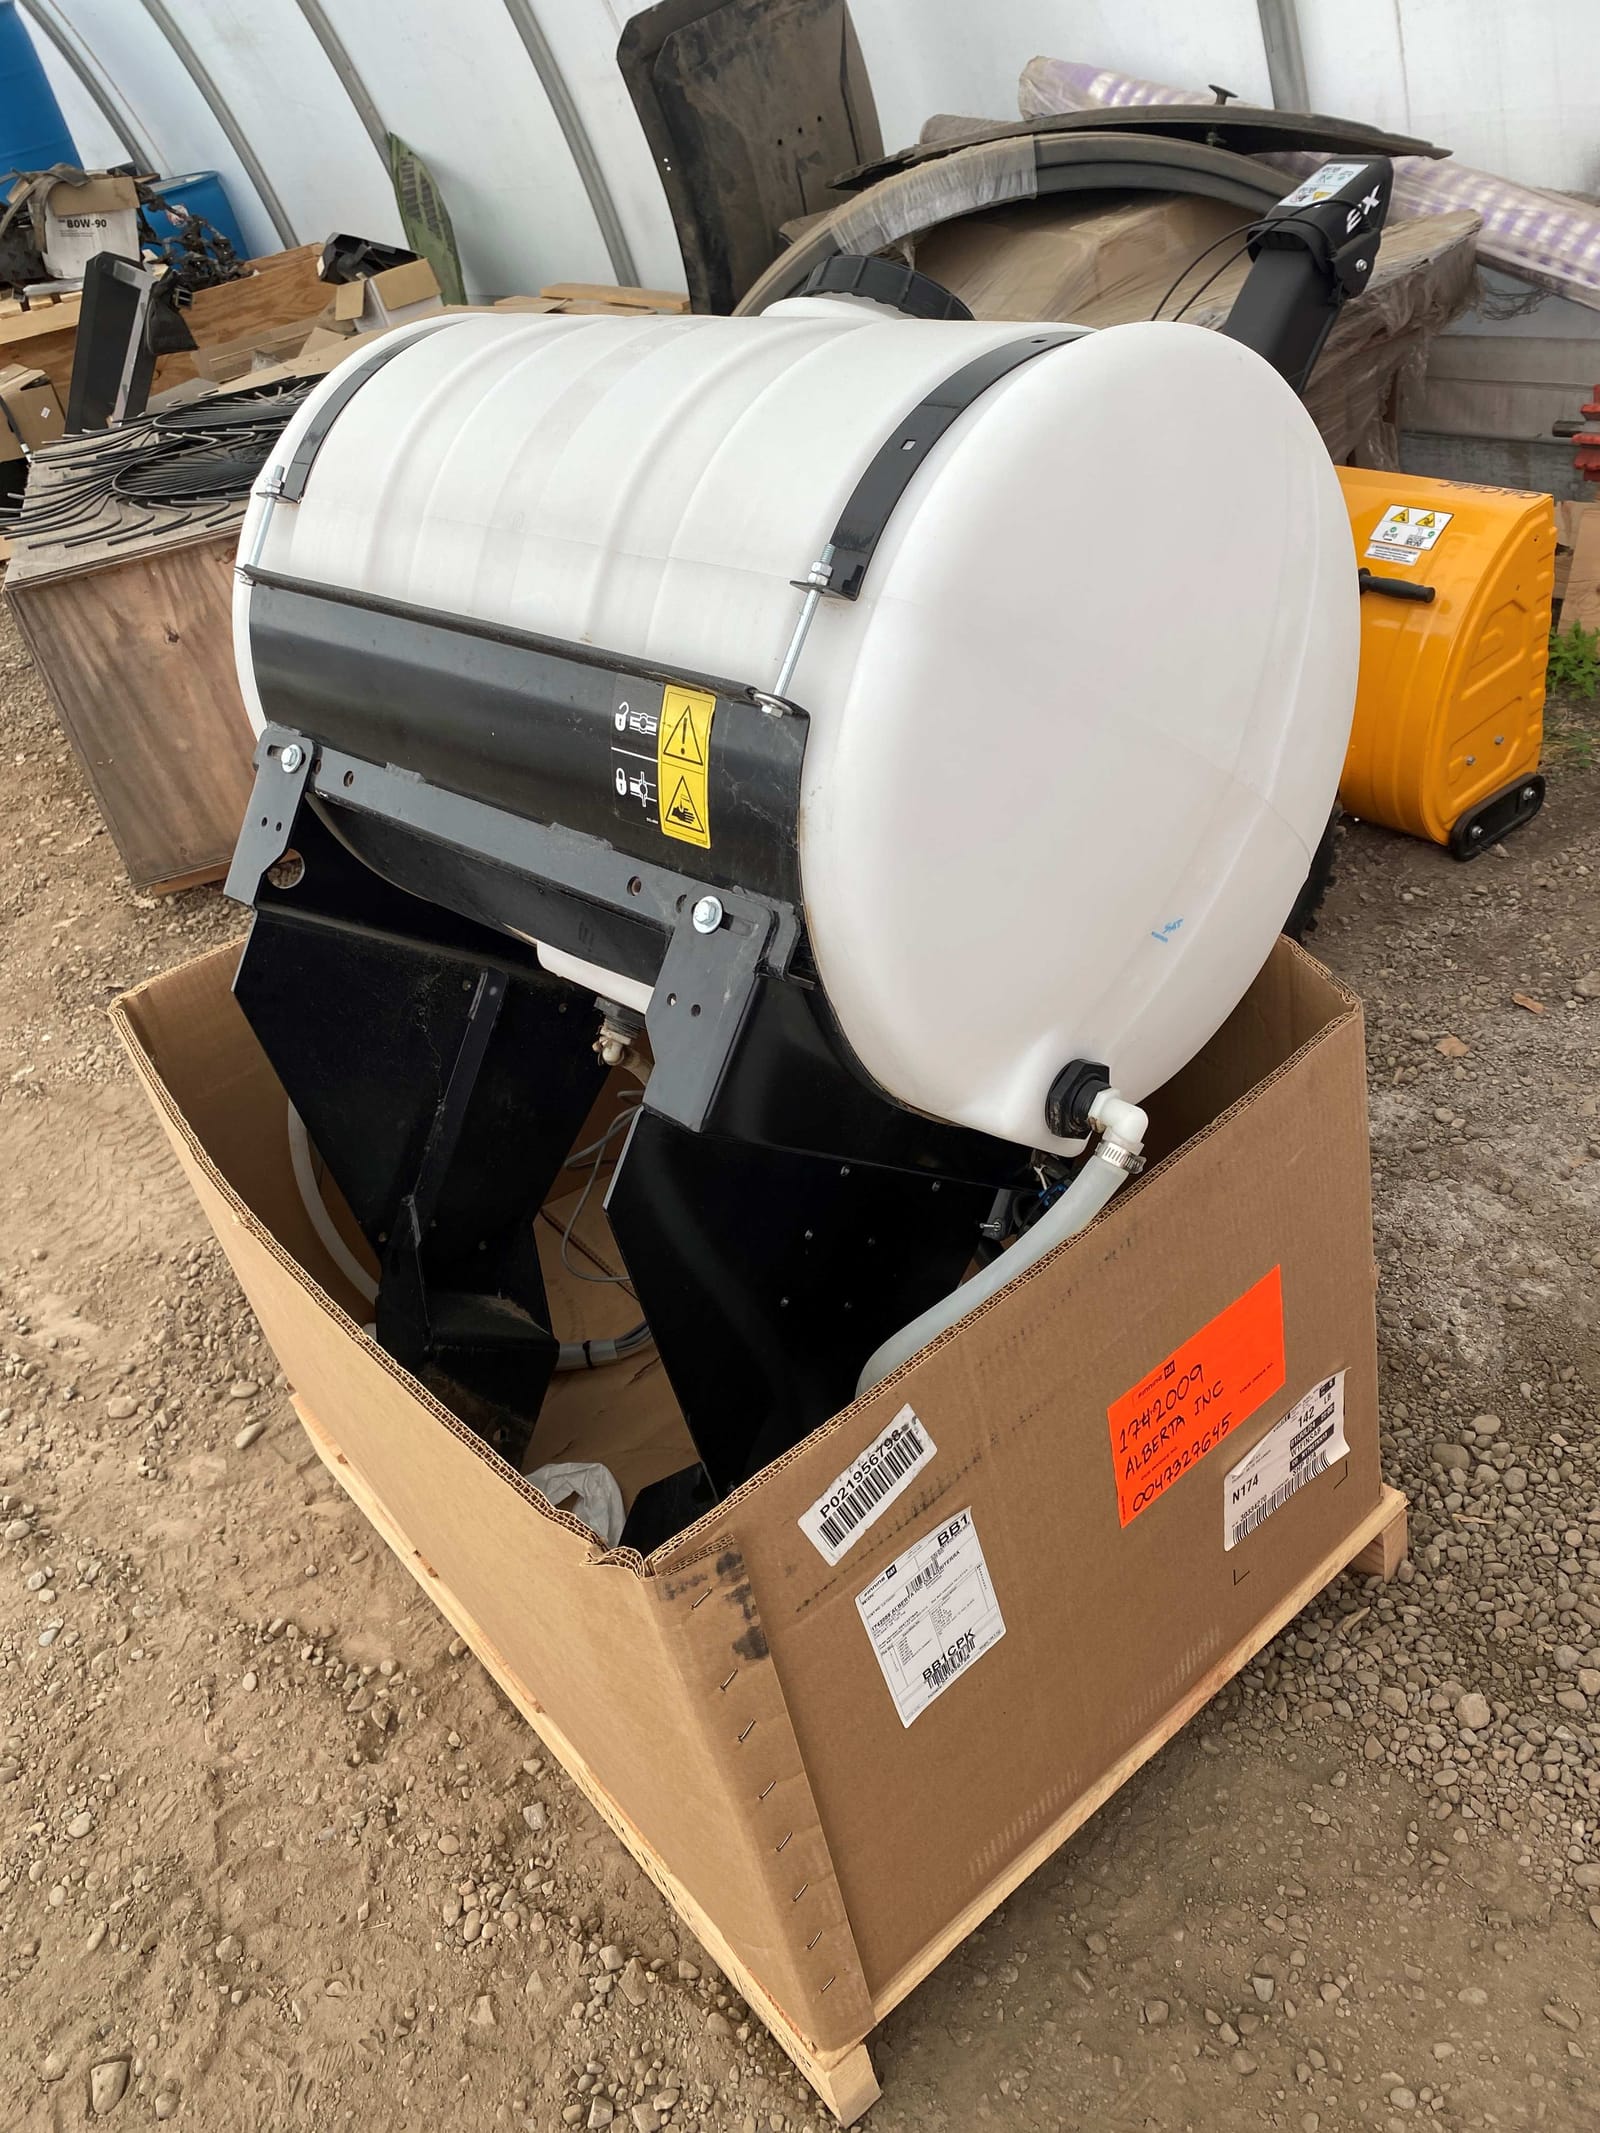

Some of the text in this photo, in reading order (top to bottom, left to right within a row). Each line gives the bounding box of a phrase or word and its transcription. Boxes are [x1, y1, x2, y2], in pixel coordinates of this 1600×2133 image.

[1120, 1364, 1203, 1453] 1742009
[1125, 1414, 1185, 1480] ALBERTA
[1194, 1380, 1224, 1416] INC
[1298, 1405, 1315, 1427] 142
[820, 1429, 901, 1519] P021956798
[1133, 1412, 1232, 1512] 0047327645
[1232, 1474, 1259, 1504] N174
[937, 1513, 969, 1547] BB1
[891, 1592, 914, 1614] ALBERTA
[922, 1628, 976, 1681] BB1CPK
